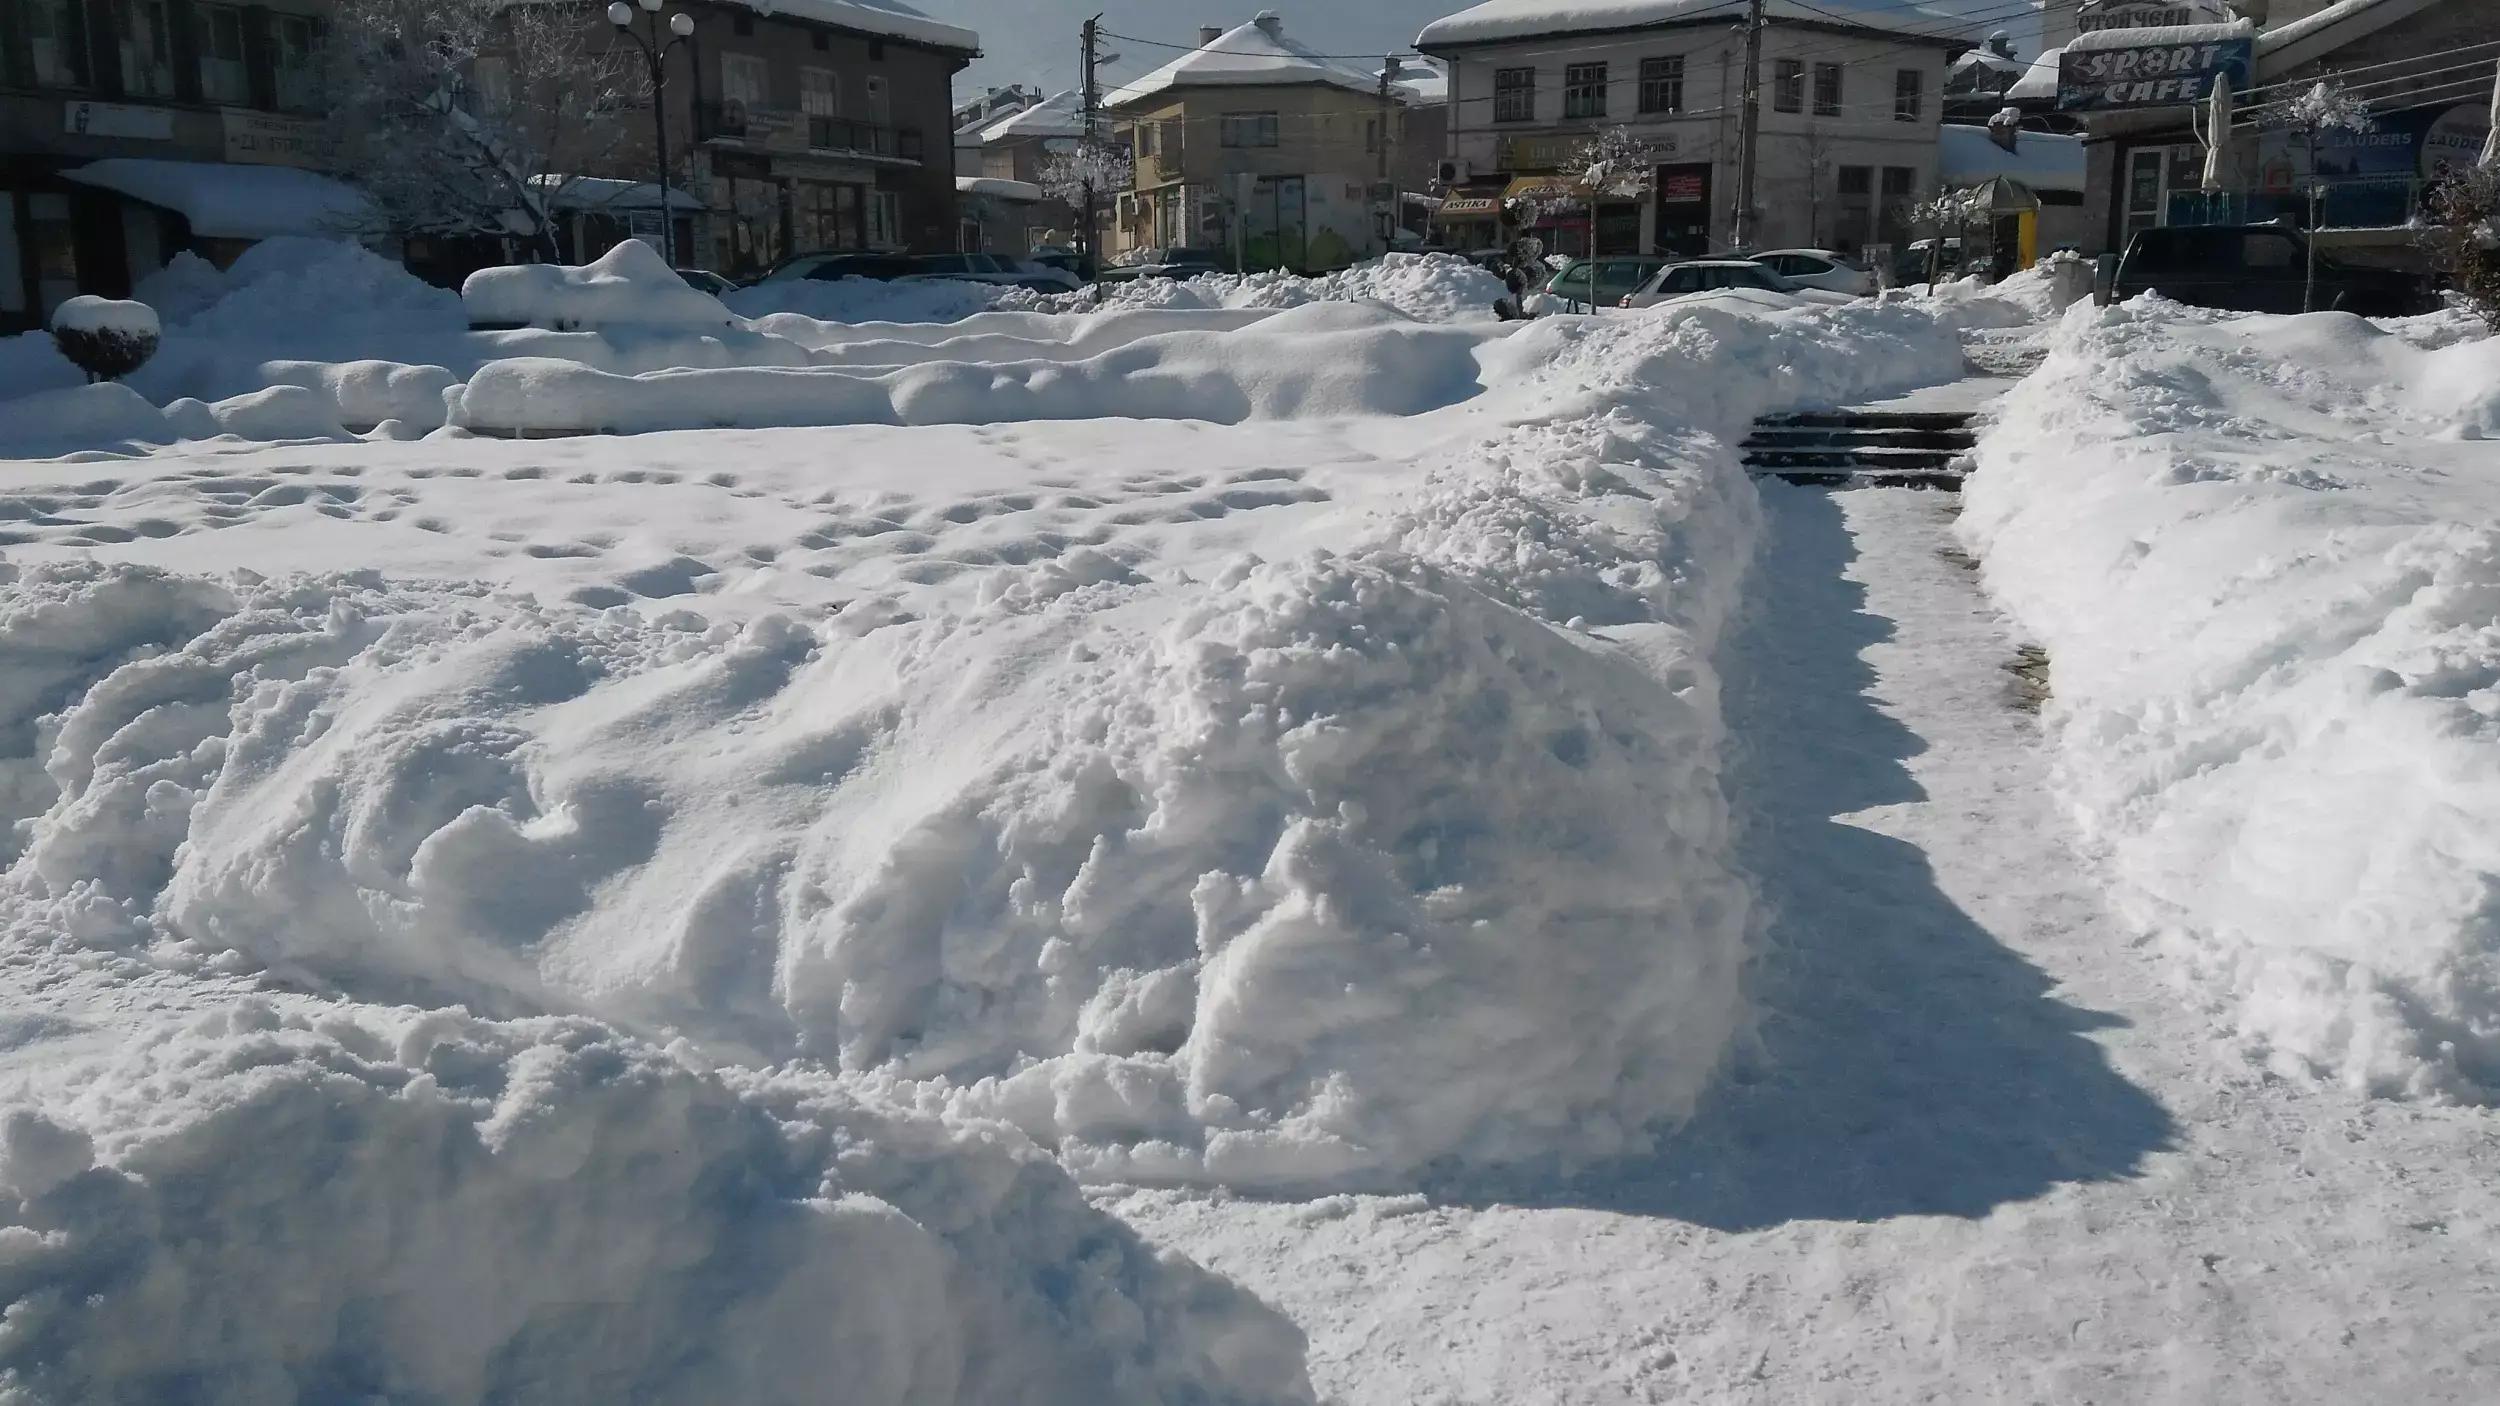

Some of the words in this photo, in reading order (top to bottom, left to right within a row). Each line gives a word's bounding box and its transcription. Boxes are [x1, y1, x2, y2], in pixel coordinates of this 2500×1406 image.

[2089, 44, 2222, 77] SPORT
[2104, 77, 2201, 103] CAFE
[2334, 133, 2413, 147] LAUDERS
[1445, 200, 1488, 209] ASTIKA
